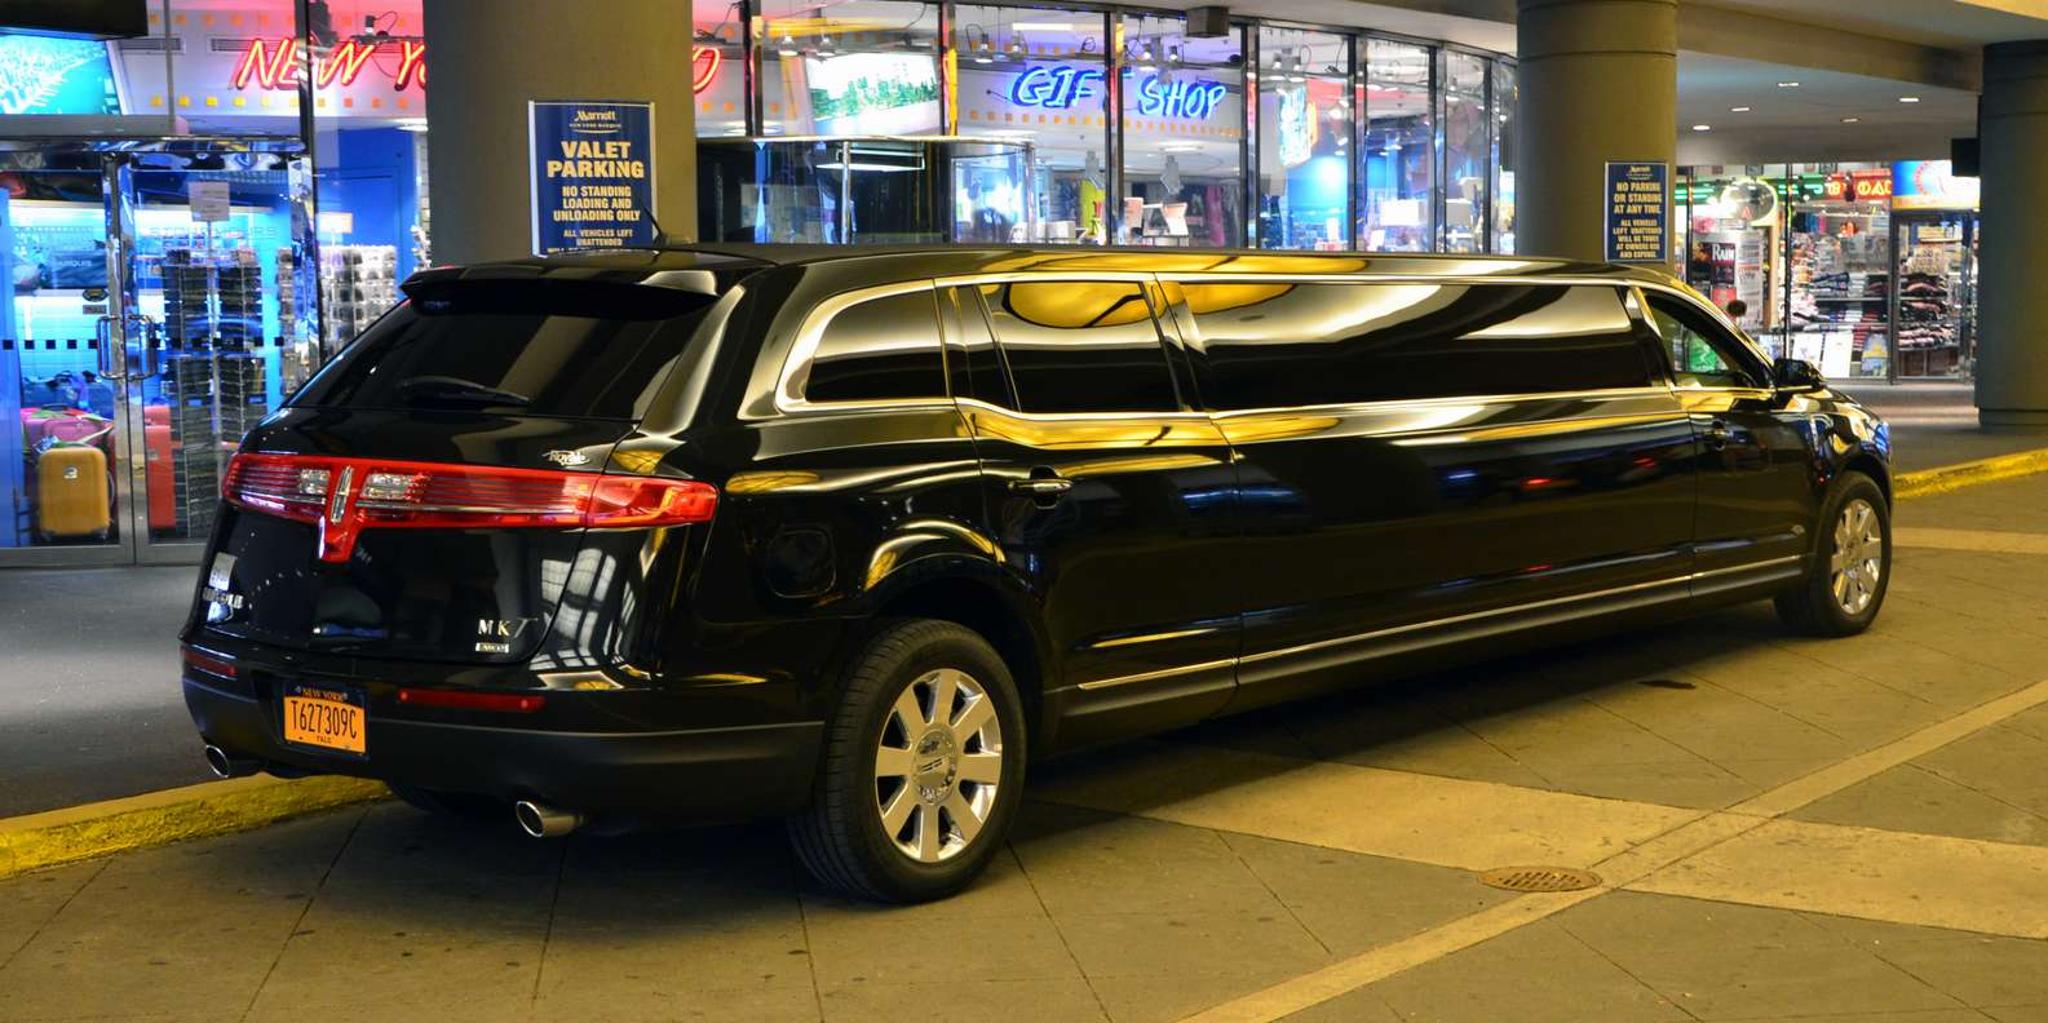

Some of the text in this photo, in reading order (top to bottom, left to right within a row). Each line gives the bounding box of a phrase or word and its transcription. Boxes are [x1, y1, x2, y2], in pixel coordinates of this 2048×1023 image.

[235, 37, 376, 90] NEW
[1138, 73, 1227, 121] SHOP
[561, 141, 631, 159] VALET
[547, 161, 645, 178] PARKING
[562, 186, 632, 197] NO STANDING
[1616, 182, 1660, 192] NO PARKING
[563, 198, 632, 209] LOADING AND
[1613, 193, 1662, 203] OR STANDING
[1613, 204, 1625, 214] AT
[1626, 204, 1643, 214] ANY
[553, 210, 641, 222] UNLOADING ONLY
[291, 700, 357, 739] T627309C
